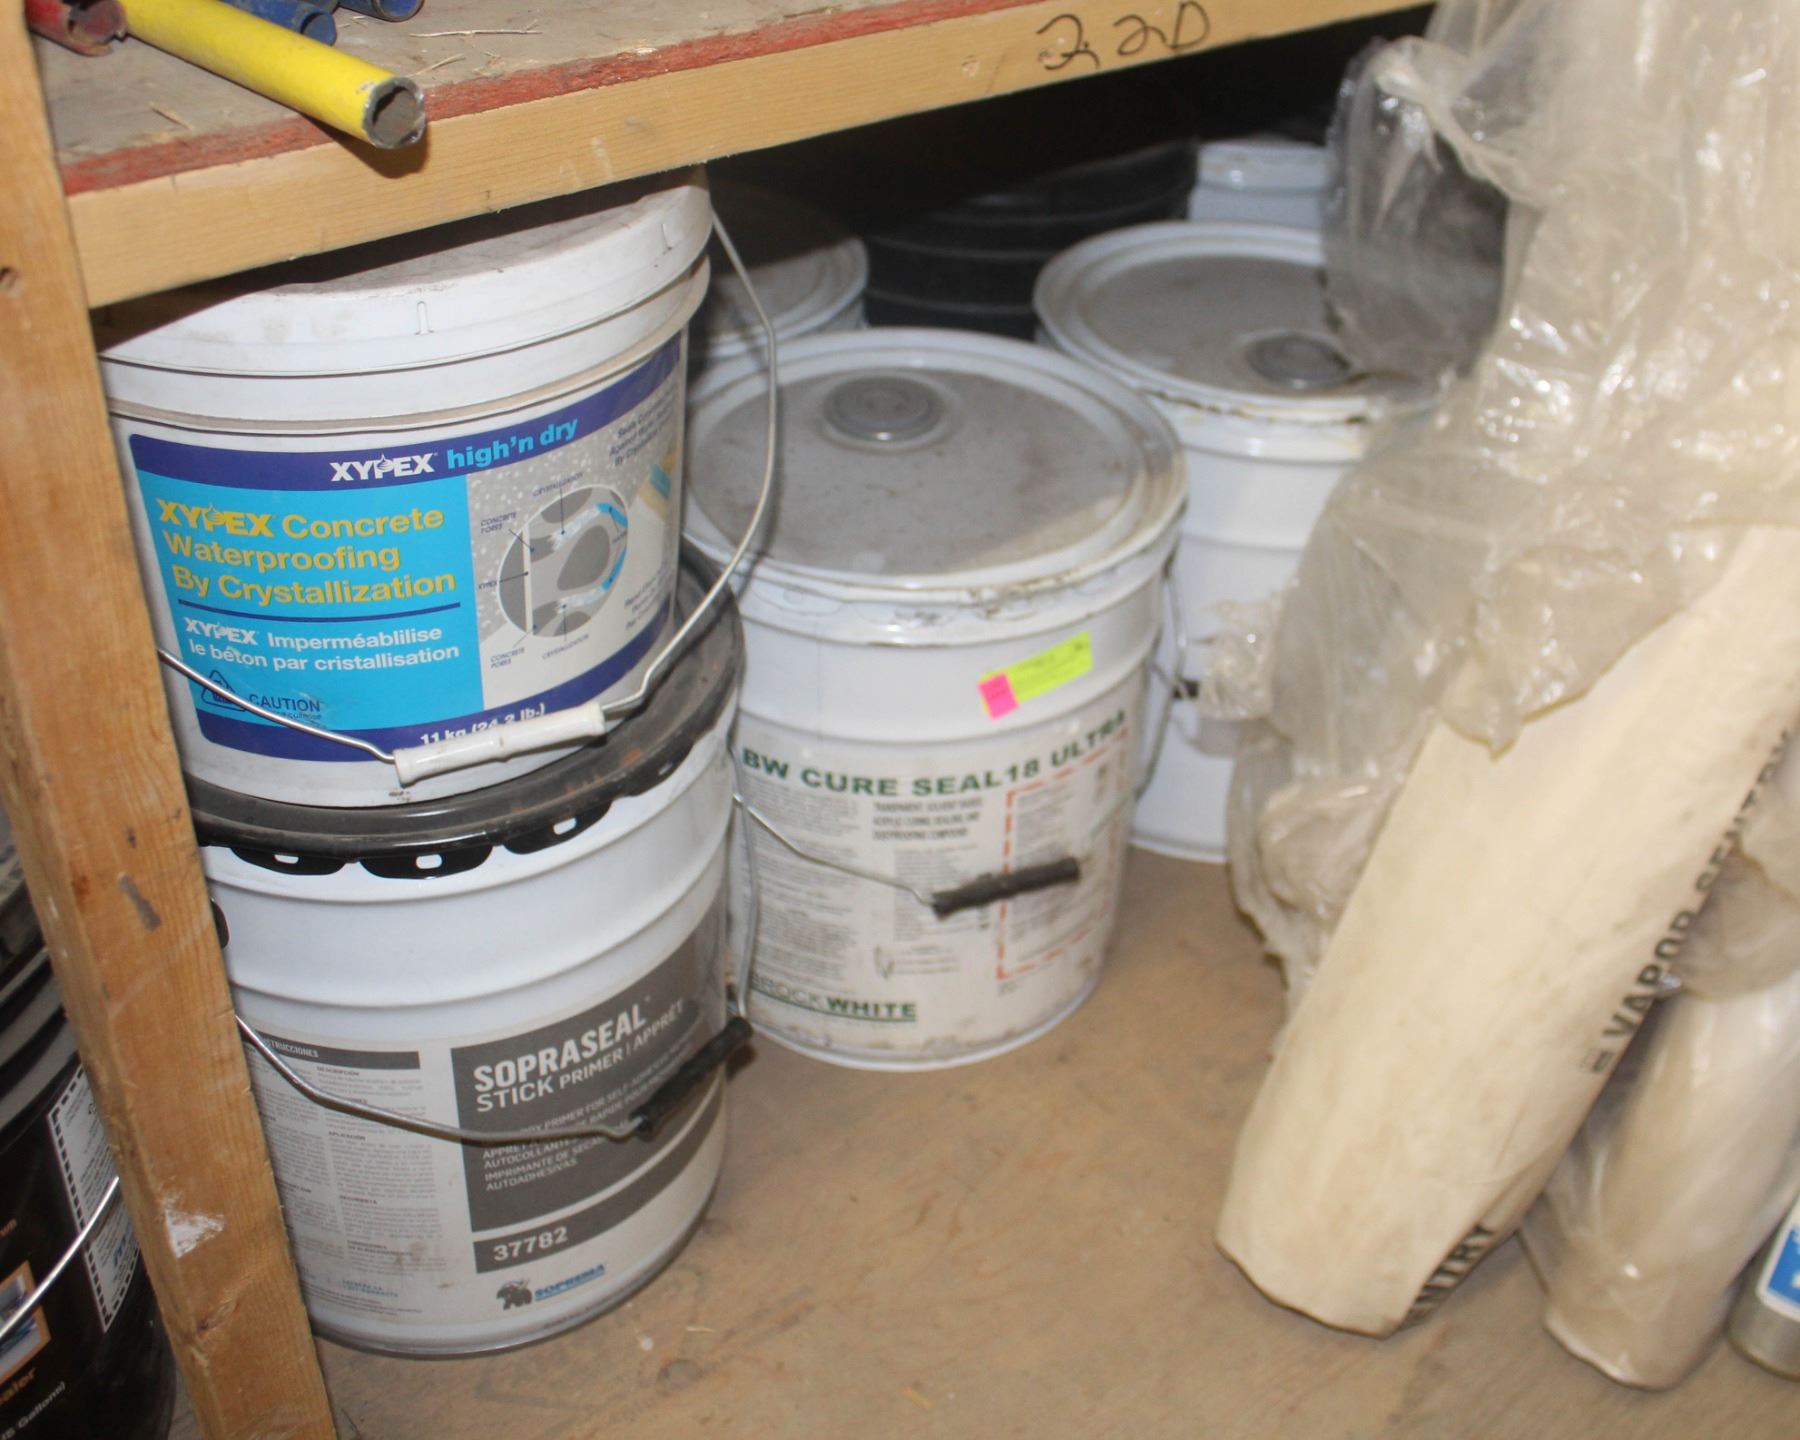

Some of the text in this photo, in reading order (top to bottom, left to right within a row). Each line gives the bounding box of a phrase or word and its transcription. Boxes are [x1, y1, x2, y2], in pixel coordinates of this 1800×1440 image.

[330, 419, 578, 482] XYPEX high'n dry
[157, 498, 444, 539] XYPEX Concrete
[163, 530, 401, 573] Waterproofing
[172, 565, 456, 607] By Crystallization
[184, 617, 443, 652] XYPEX Imperméablilise
[189, 639, 206, 656] le
[273, 656, 309, 671] par
[314, 646, 460, 670] cristallisation
[249, 694, 321, 712] CAUTION
[420, 733, 440, 745] 11
[737, 748, 790, 780] BW
[800, 768, 898, 796] CURE
[827, 996, 917, 1018] WHITE
[473, 1003, 647, 1093] SOPRASEAL
[476, 1076, 553, 1112] STICK
[559, 1047, 623, 1089] PRIMER
[493, 1226, 569, 1261] 37782
[18, 1381, 66, 1430] Gallons)
